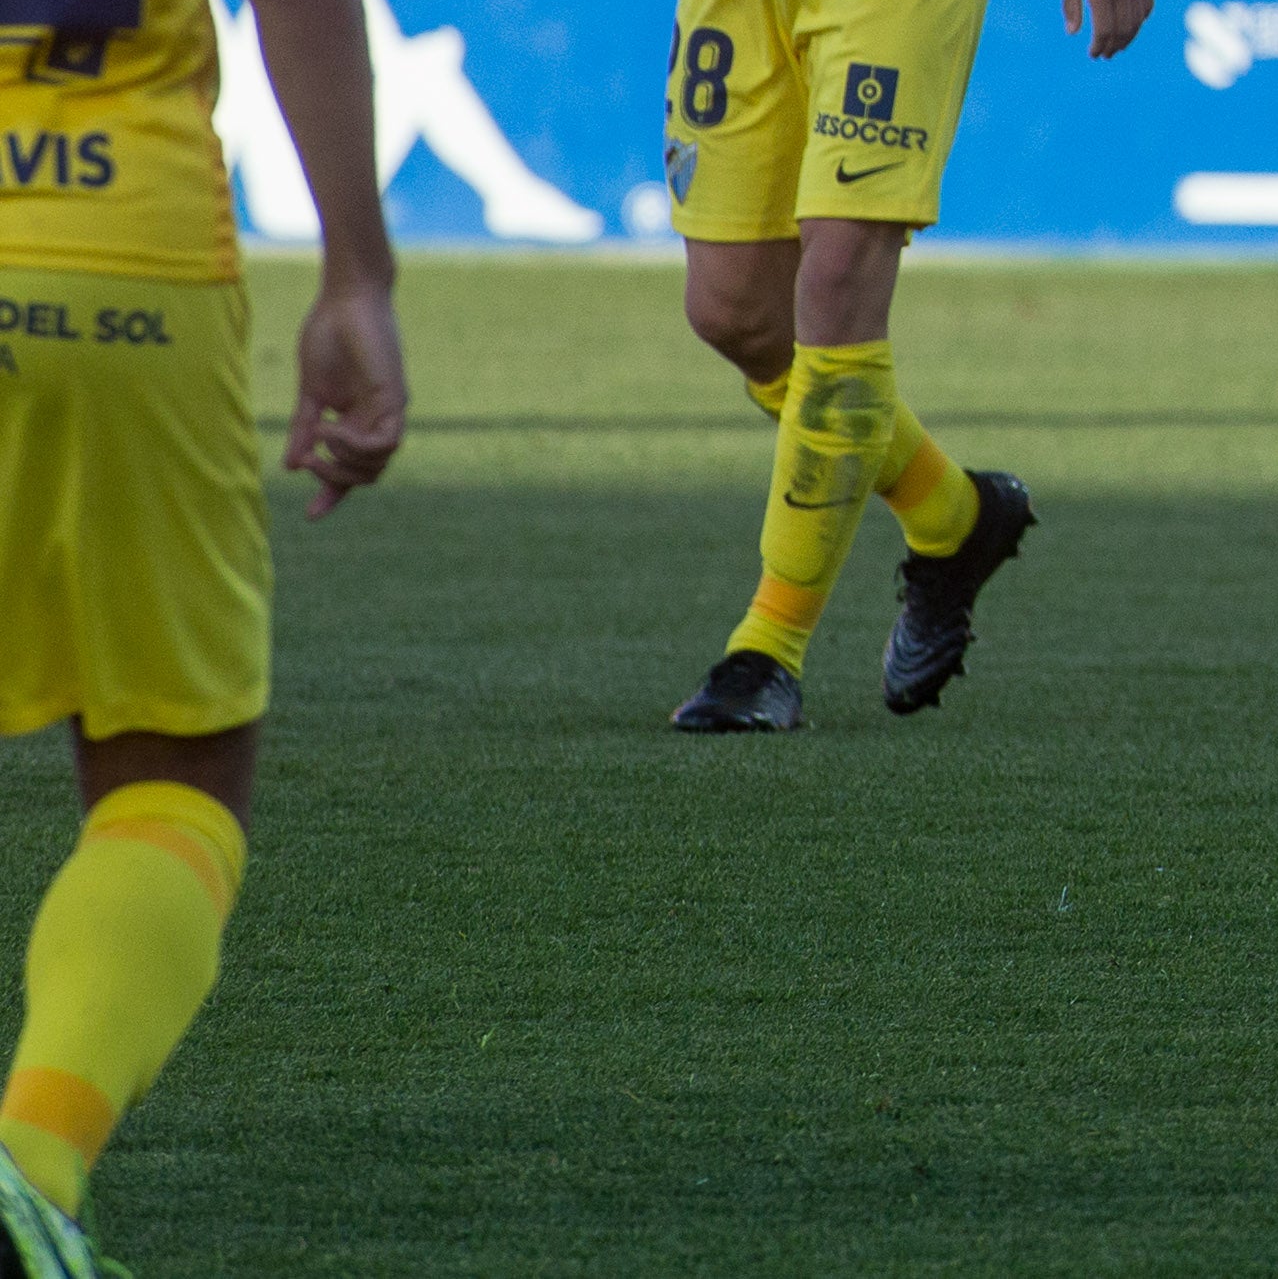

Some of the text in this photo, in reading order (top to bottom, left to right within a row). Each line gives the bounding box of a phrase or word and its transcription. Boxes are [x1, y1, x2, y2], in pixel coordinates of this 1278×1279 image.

[667, 22, 734, 129] 8
[0, 132, 114, 188] VIS
[96, 308, 173, 345] SOL
